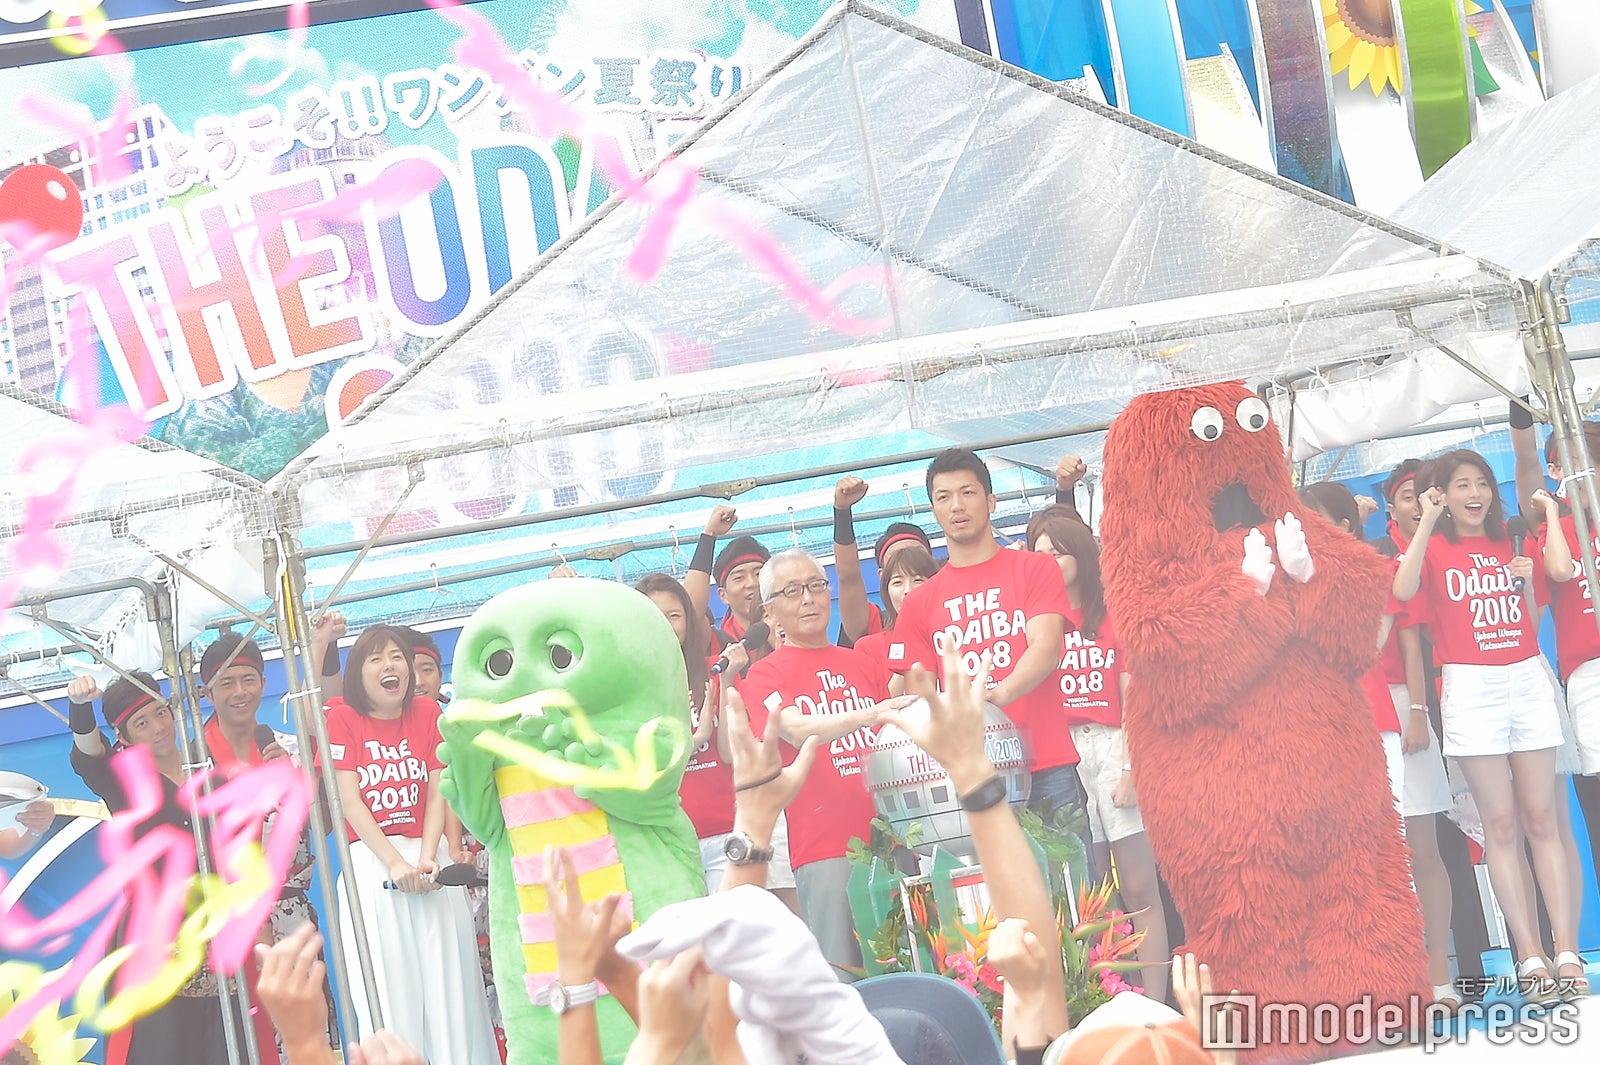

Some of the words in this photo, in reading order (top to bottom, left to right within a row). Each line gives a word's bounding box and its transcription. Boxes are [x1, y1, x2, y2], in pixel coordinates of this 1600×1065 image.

[46, 174, 366, 413] THE
[1468, 553, 1500, 569] The
[943, 587, 1002, 622] THE
[1469, 595, 1523, 629] 2018
[932, 609, 1027, 657] ODAIBA
[962, 640, 1012, 677] 018
[1057, 647, 1115, 671] AIBA
[815, 669, 848, 692] The
[1060, 670, 1104, 695] 018
[364, 738, 412, 761] THE
[907, 753, 937, 776] THE
[995, 737, 1023, 761] 2018
[365, 783, 420, 813] 2018
